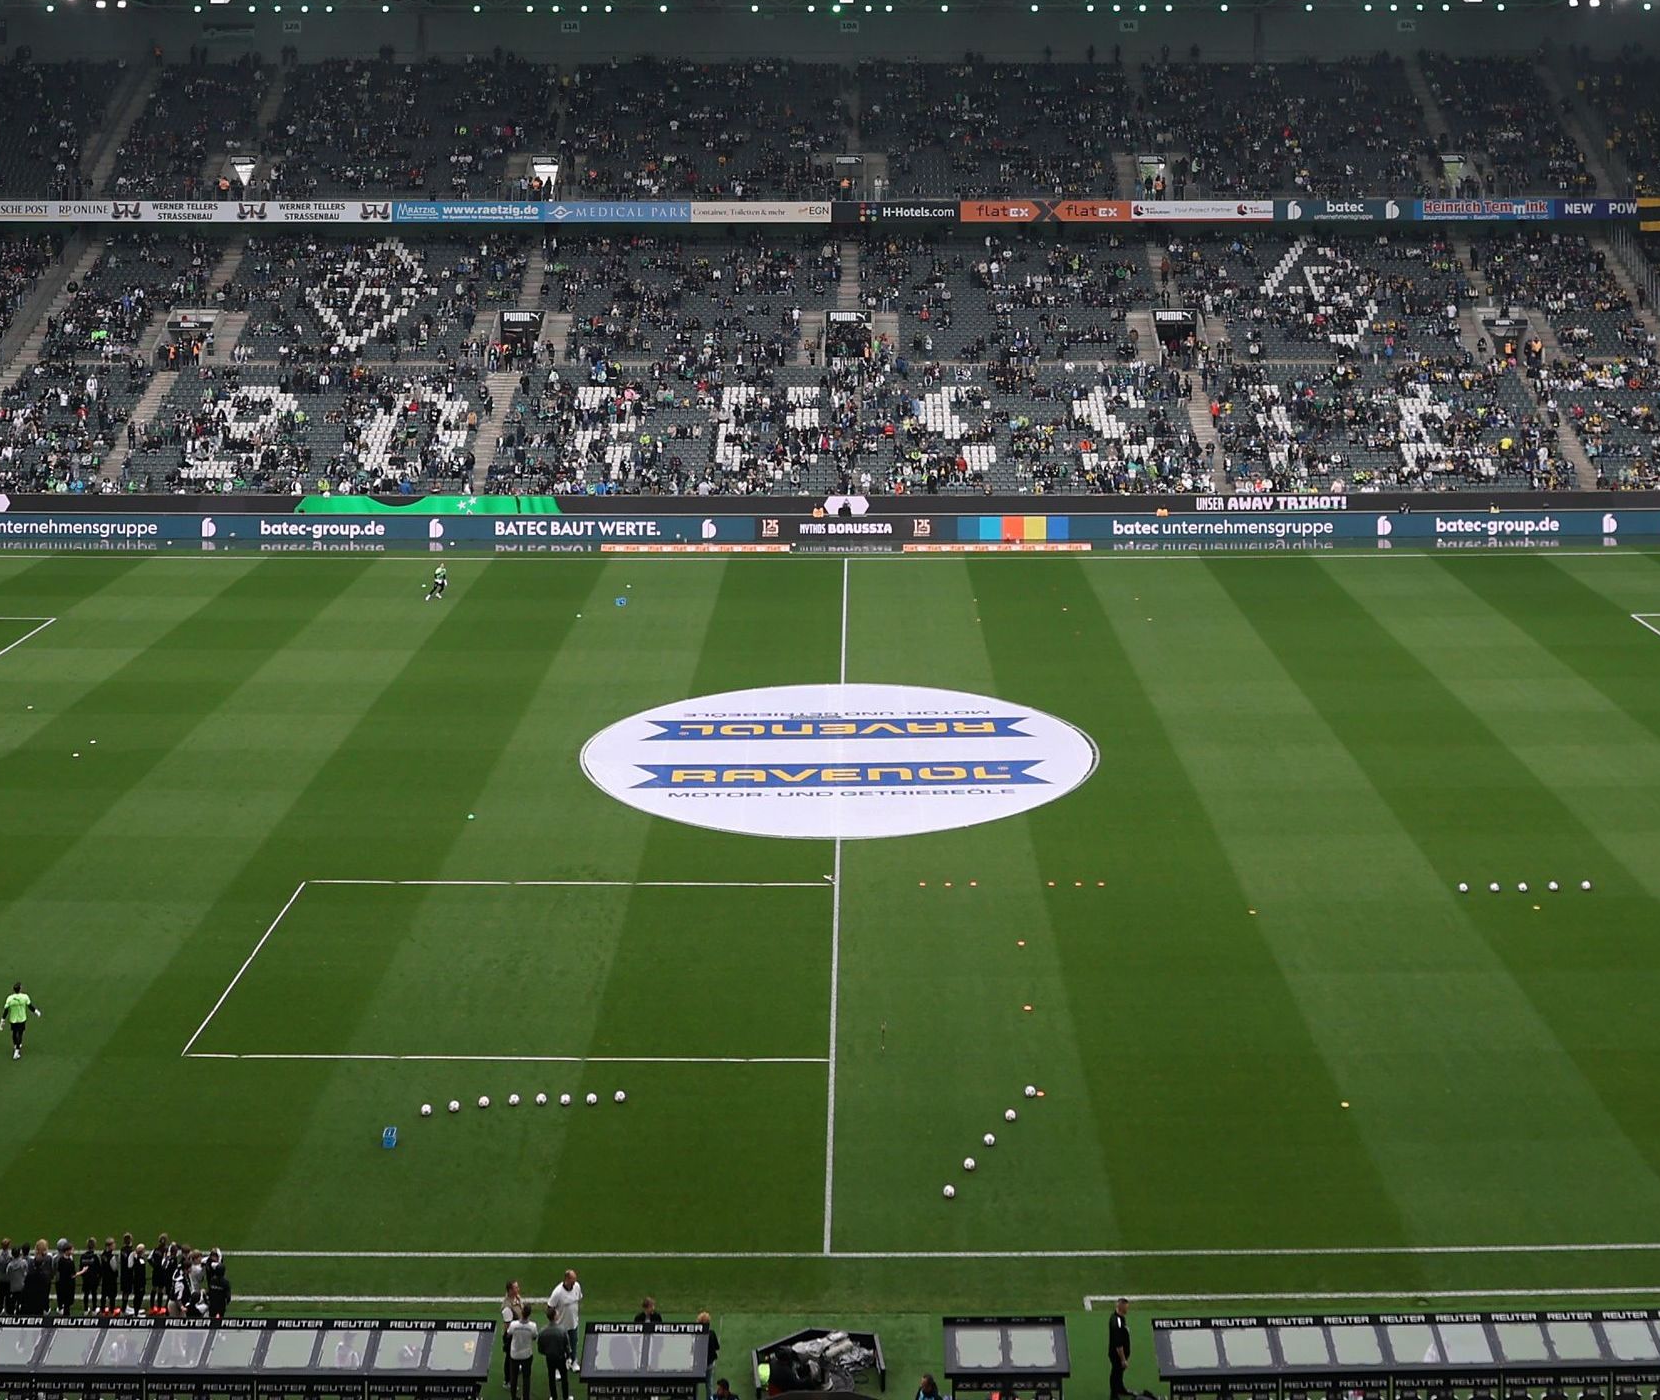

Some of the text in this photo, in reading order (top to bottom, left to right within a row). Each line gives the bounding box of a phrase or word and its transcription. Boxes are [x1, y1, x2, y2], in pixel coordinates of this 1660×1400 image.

[23, 205, 49, 214] POST
[59, 205, 108, 214] RP ONLINE
[151, 202, 218, 211] WERNER TELLERS
[443, 205, 539, 217] www.raetzig.de
[575, 206, 688, 218] MEDICAL PARK
[809, 207, 830, 215] EGN
[882, 207, 955, 217] H-Hotels.com
[1326, 201, 1364, 212] batec
[1423, 201, 1548, 215] Heinrich Temmink
[1564, 203, 1594, 214] NEW
[157, 212, 213, 221] STRASSENBAU
[504, 312, 530, 322] PUMA
[830, 312, 856, 322] PUMA
[1156, 311, 1182, 321] PUMA
[1196, 495, 1347, 511] UNSER AWAY TRIKOT!
[260, 520, 385, 539] batec-group.de
[495, 520, 661, 537] BATEC BAUT WERTE.
[799, 523, 892, 534] MYTHOS BORUSSIA
[680, 721, 996, 736] RAVENOL
[670, 765, 1012, 783] RAVENOL
[446, 1321, 492, 1330] REUTER
